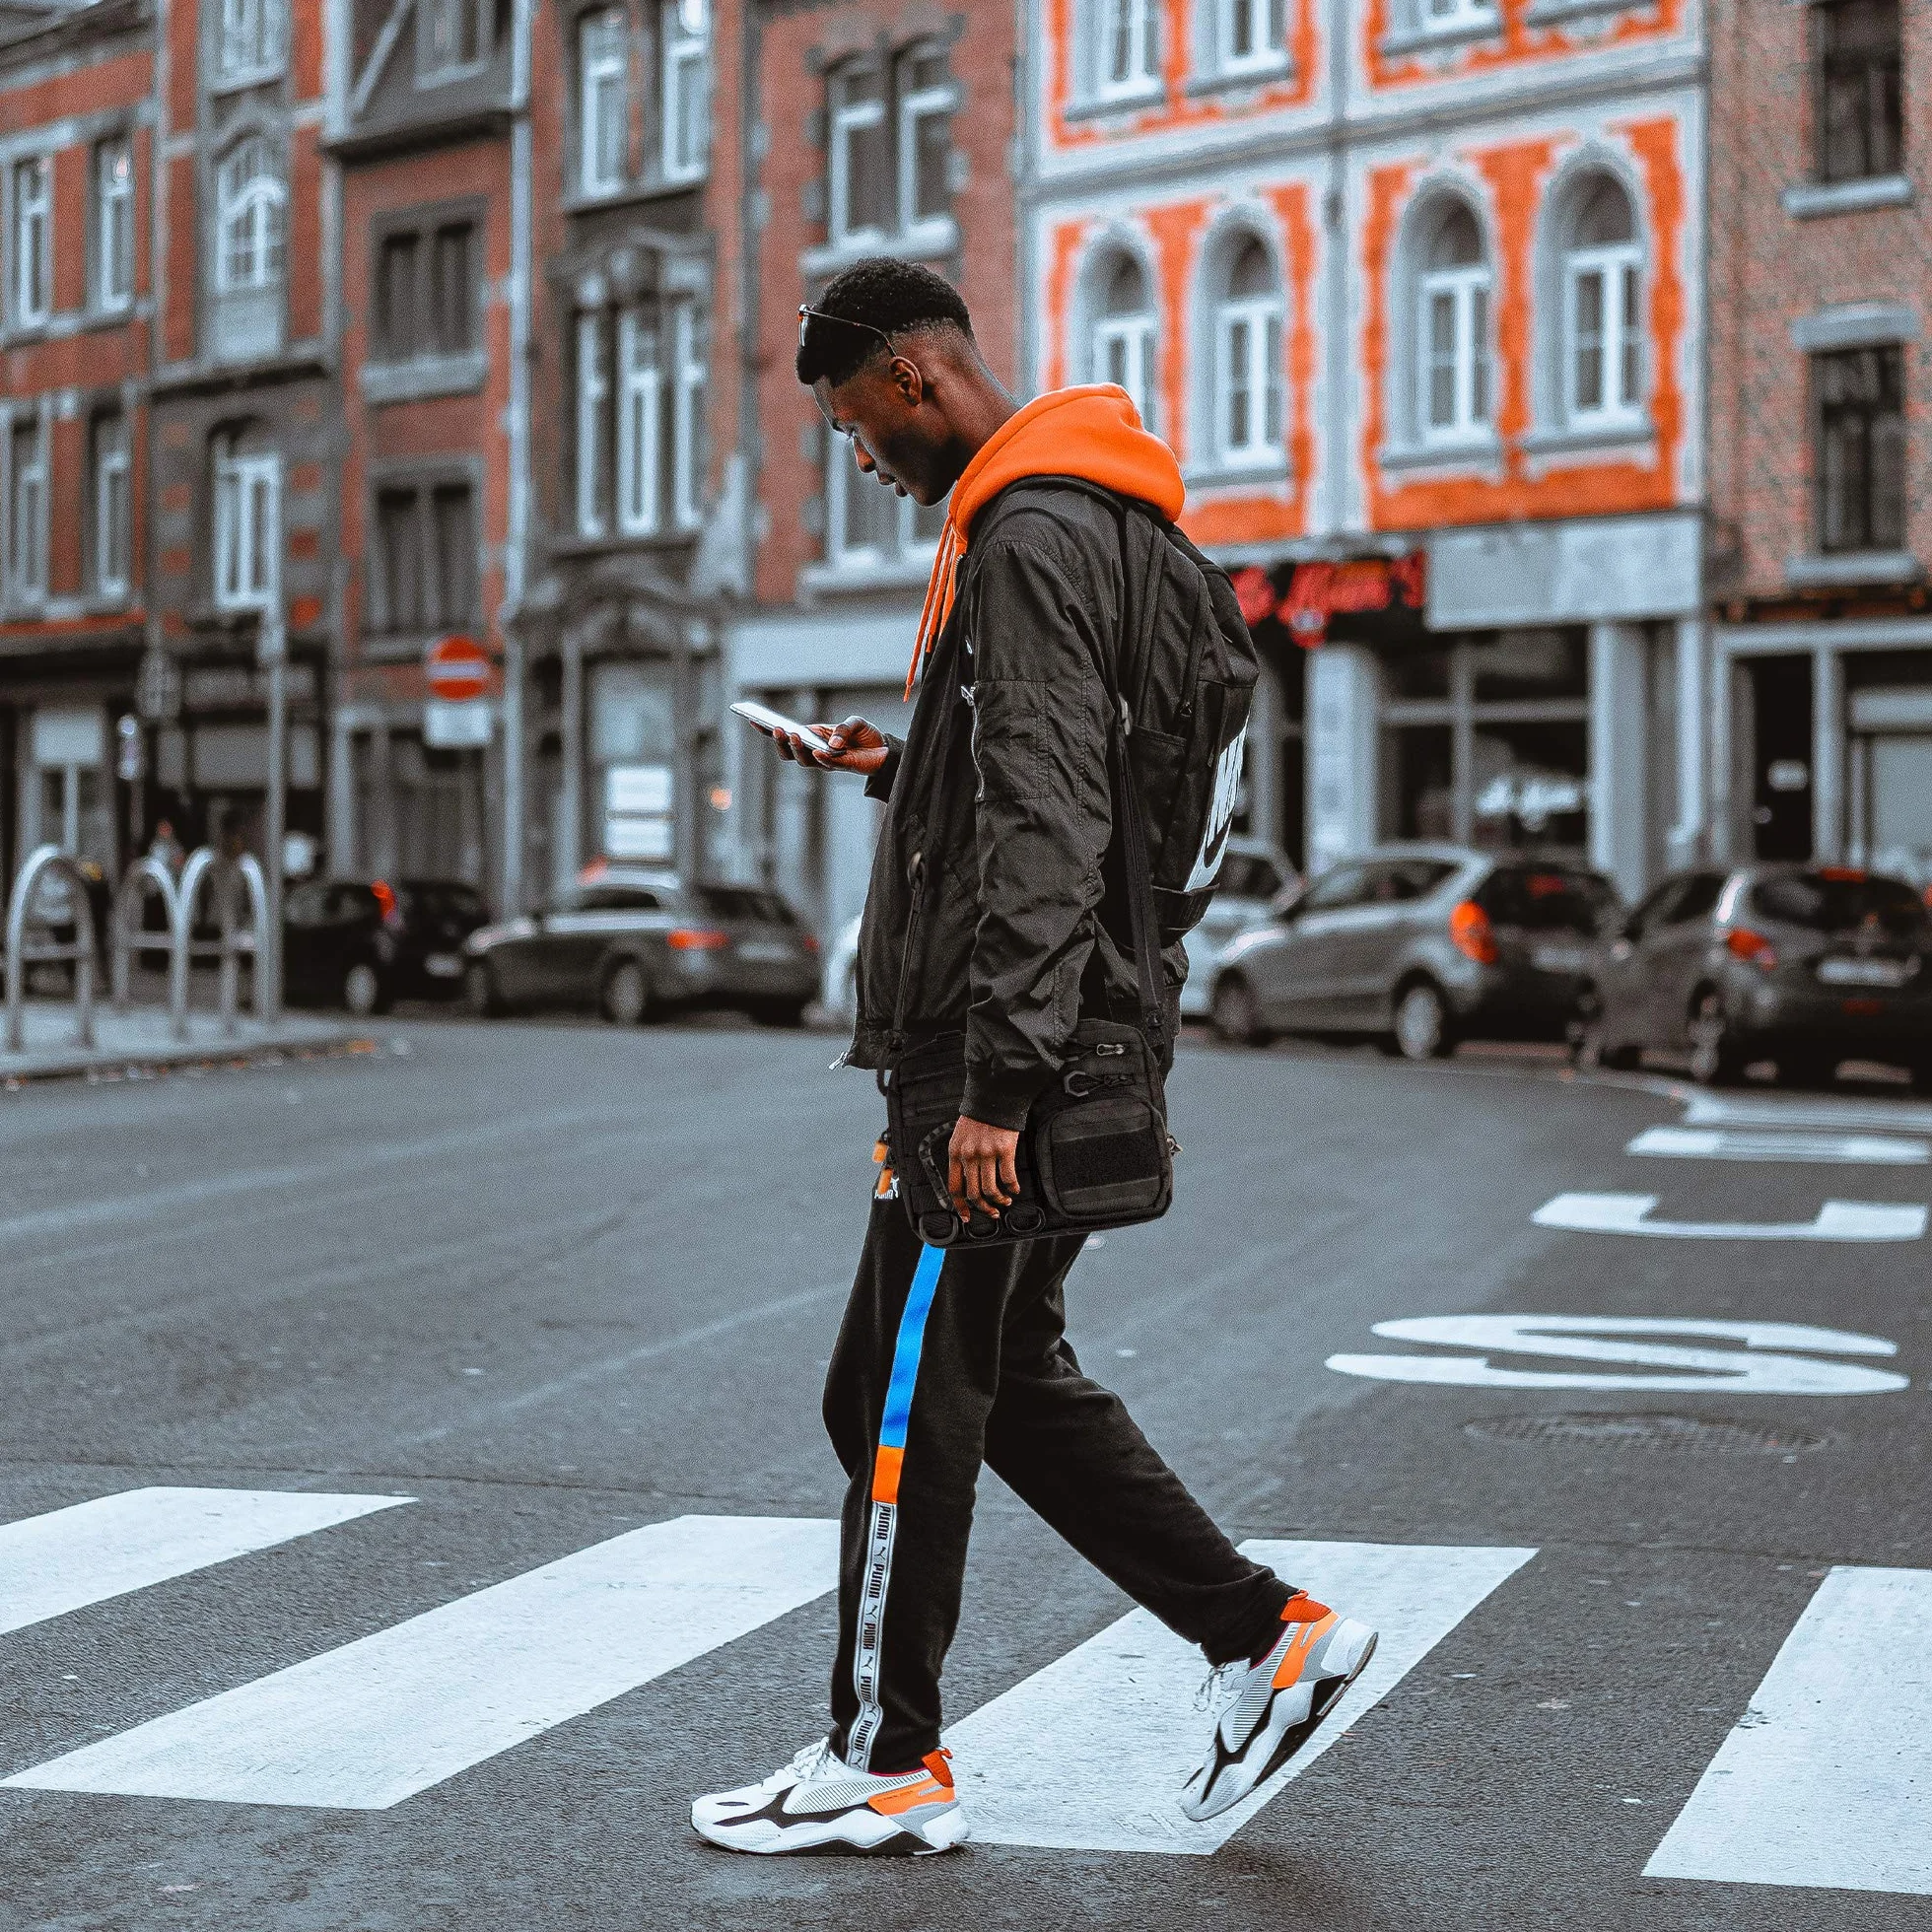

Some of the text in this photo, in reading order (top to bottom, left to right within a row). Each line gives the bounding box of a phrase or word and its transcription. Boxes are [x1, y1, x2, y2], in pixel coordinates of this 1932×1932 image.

[876, 1504, 891, 1541] PUMA
[868, 1563, 885, 1599] PUMA
[862, 1622, 876, 1650] PUMA
[854, 1720, 873, 1752] PUMA
